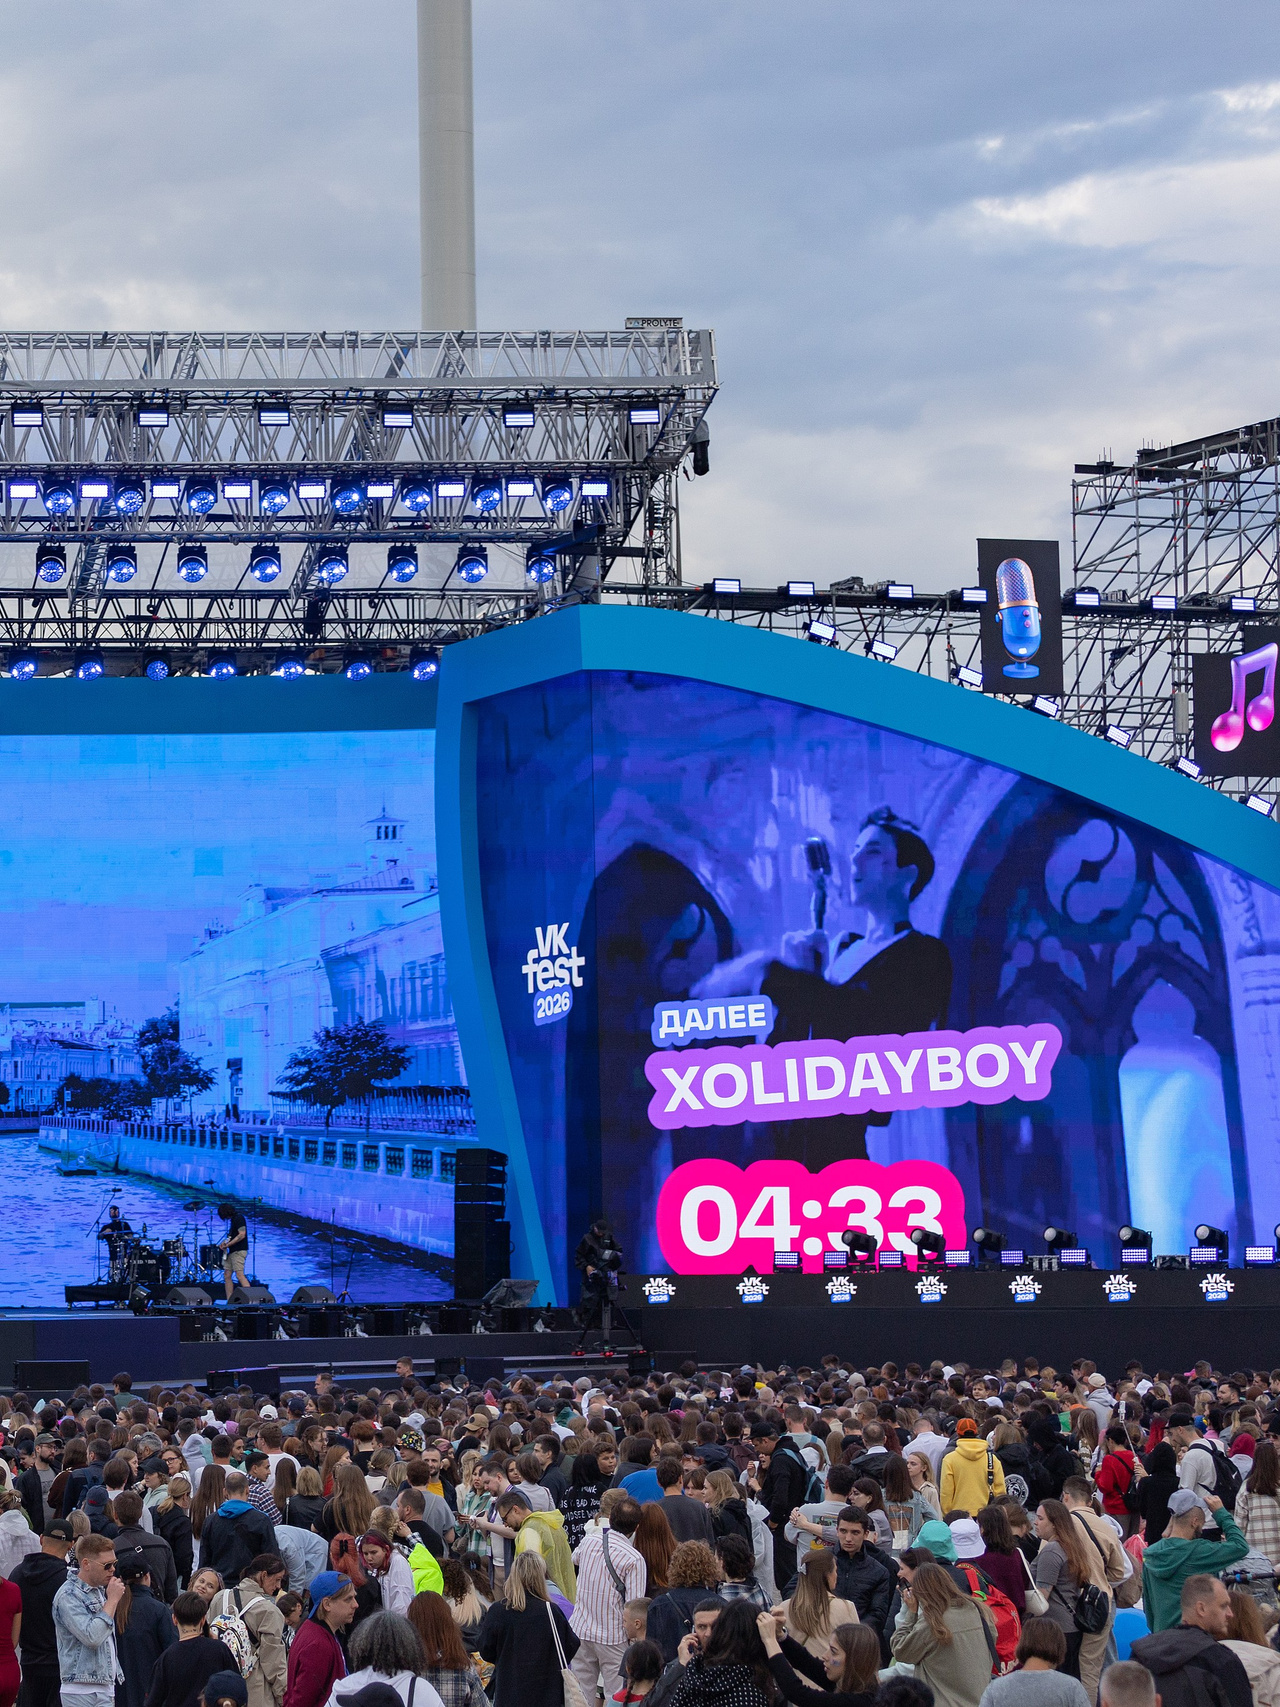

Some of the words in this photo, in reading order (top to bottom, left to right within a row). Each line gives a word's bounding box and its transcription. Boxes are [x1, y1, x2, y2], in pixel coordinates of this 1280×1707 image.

[641, 319, 678, 327] PROLYTE
[535, 922, 570, 957] VK
[522, 946, 586, 994] fest
[536, 991, 570, 1019] 2026
[659, 1003, 767, 1039] ДАЛЕЕ
[660, 1040, 1047, 1112] XOLIDAYBOY
[680, 1185, 943, 1257] 04:33
[649, 1277, 668, 1287] VK
[743, 1276, 762, 1286] VK
[832, 1276, 850, 1286] VK
[922, 1276, 940, 1286] VK
[1015, 1275, 1034, 1285] VK
[1109, 1274, 1128, 1284] VK
[1206, 1273, 1226, 1283] VK
[642, 1284, 677, 1295] fest
[736, 1283, 770, 1295] fest
[825, 1282, 858, 1295] fest
[915, 1282, 948, 1294] fest
[1008, 1281, 1042, 1294] fest
[1102, 1281, 1137, 1293] fest
[1199, 1280, 1235, 1292] fest
[576, 1499, 588, 1507] BAD
